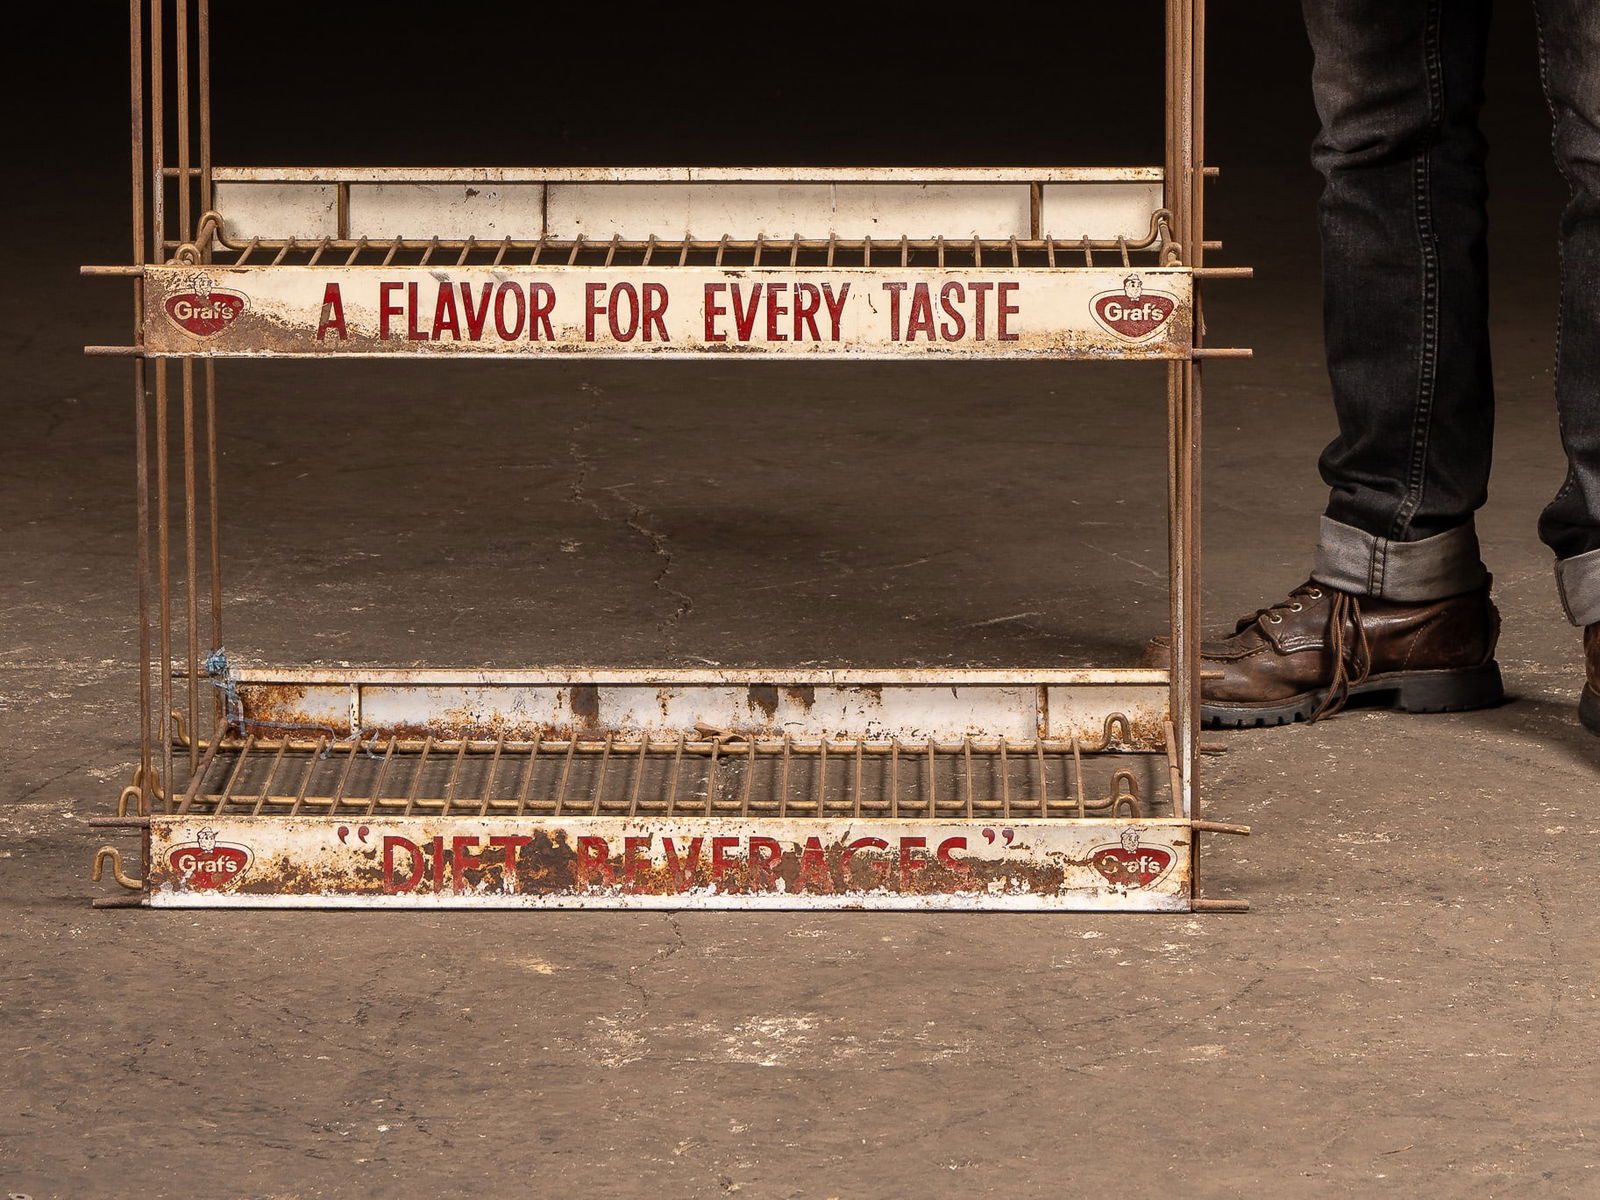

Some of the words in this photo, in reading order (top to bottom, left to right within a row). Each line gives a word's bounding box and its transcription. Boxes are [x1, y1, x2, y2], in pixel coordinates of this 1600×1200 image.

[174, 301, 234, 321] Graf's
[316, 282, 348, 341] A
[379, 281, 557, 342] FLAVOR
[584, 282, 670, 342] FOR
[703, 282, 852, 342] EVERY
[882, 281, 1020, 342] TASTE
[1104, 302, 1165, 322] Graf's
[178, 854, 238, 875] Graf's
